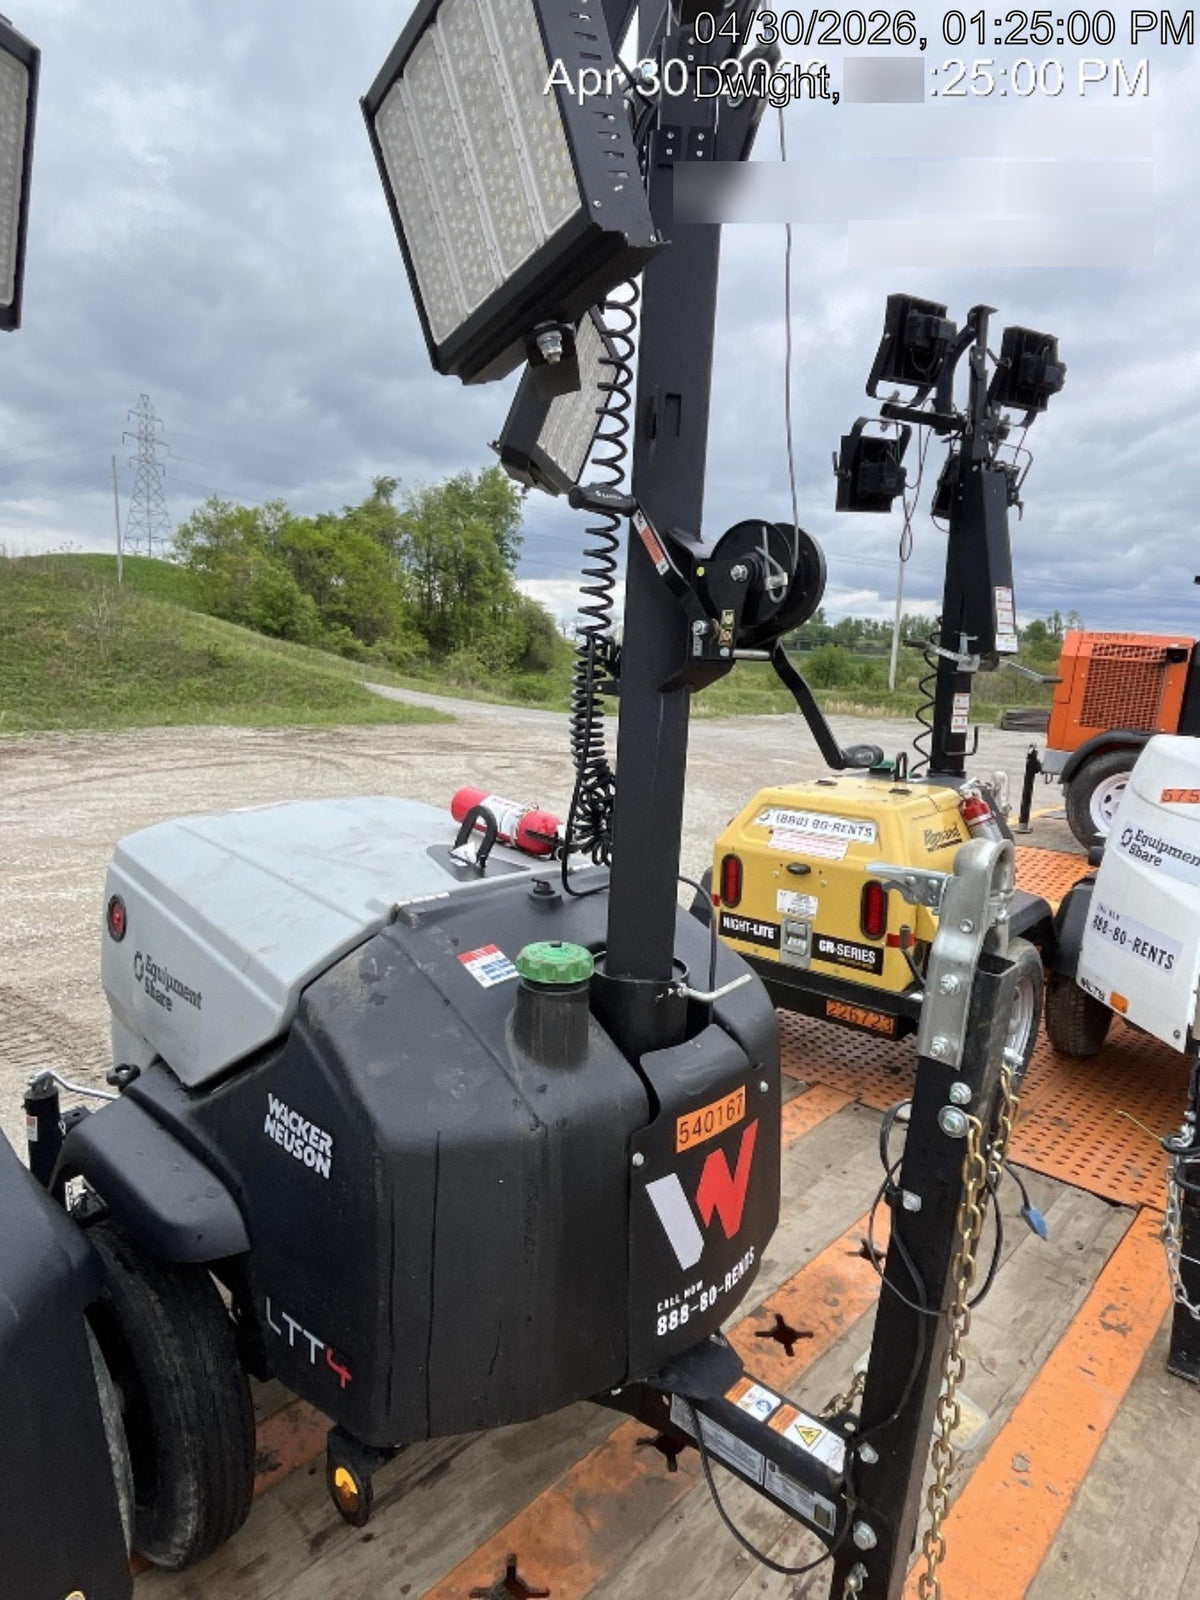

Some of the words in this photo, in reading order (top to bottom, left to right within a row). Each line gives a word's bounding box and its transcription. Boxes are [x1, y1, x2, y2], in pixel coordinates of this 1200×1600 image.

[1128, 842, 1162, 867] Share
[722, 916, 776, 940] NIGHT-LITE
[819, 939, 876, 964] GR-SERIES
[144, 976, 173, 1012] Share
[145, 954, 203, 1011] Equipment
[267, 1093, 333, 1158] WACKER
[679, 1093, 744, 1146] 540167
[264, 1114, 331, 1180] NEUSON
[657, 1246, 755, 1336] 888-80-RENTS
